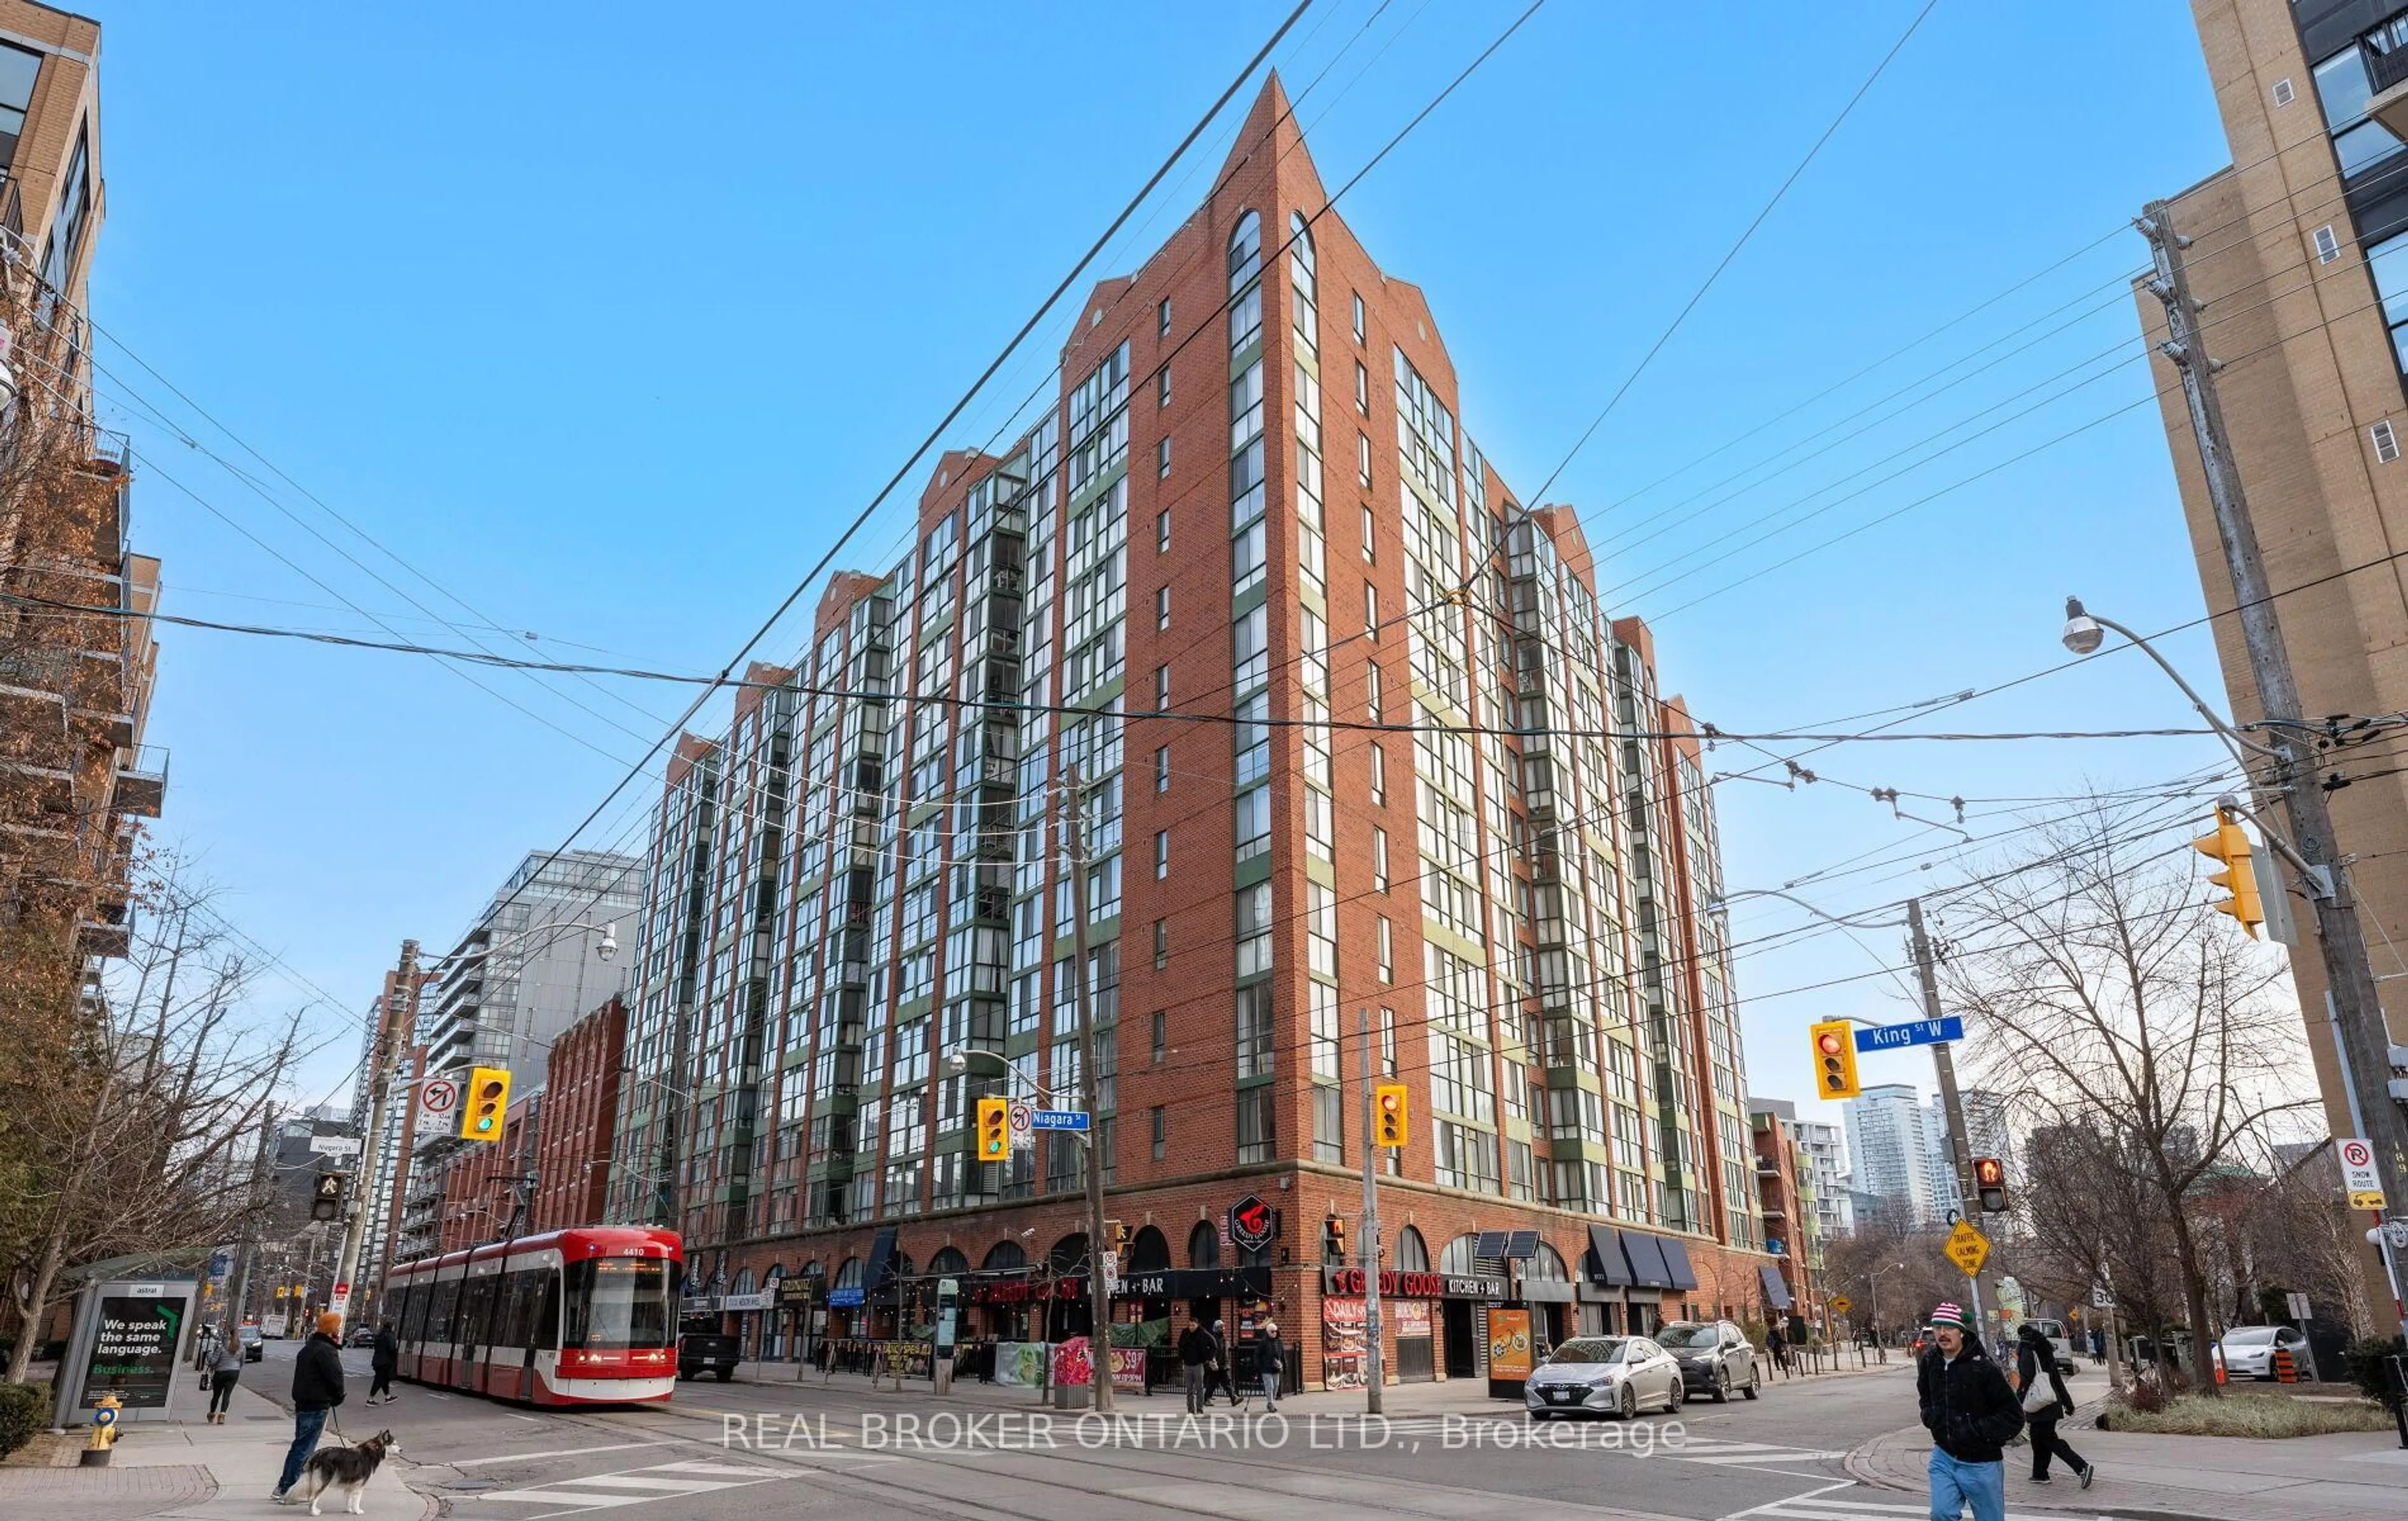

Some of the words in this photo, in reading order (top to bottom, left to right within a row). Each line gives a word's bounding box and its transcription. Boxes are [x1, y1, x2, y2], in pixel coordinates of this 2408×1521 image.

[1873, 1027, 1911, 1044] King
[1928, 1020, 1941, 1036] W
[1034, 1112, 1072, 1127] Niagara
[1953, 1232, 1976, 1243] TRAFFIC
[1956, 1244, 1980, 1256] CALMING
[1963, 1258, 1978, 1268] ZONE
[1143, 1278, 1164, 1293] BAR
[1404, 1272, 1442, 1296] GOOSE
[1449, 1278, 1478, 1295] KITCHEN
[1487, 1281, 1501, 1295] BAR
[2096, 1292, 2114, 1303] 30
[1333, 1301, 1358, 1317] DAILY
[105, 1319, 125, 1330] We
[128, 1319, 167, 1332] speak
[100, 1331, 123, 1342] the
[125, 1333, 161, 1342] same
[97, 1343, 162, 1356] language.
[93, 1364, 155, 1375] Business.
